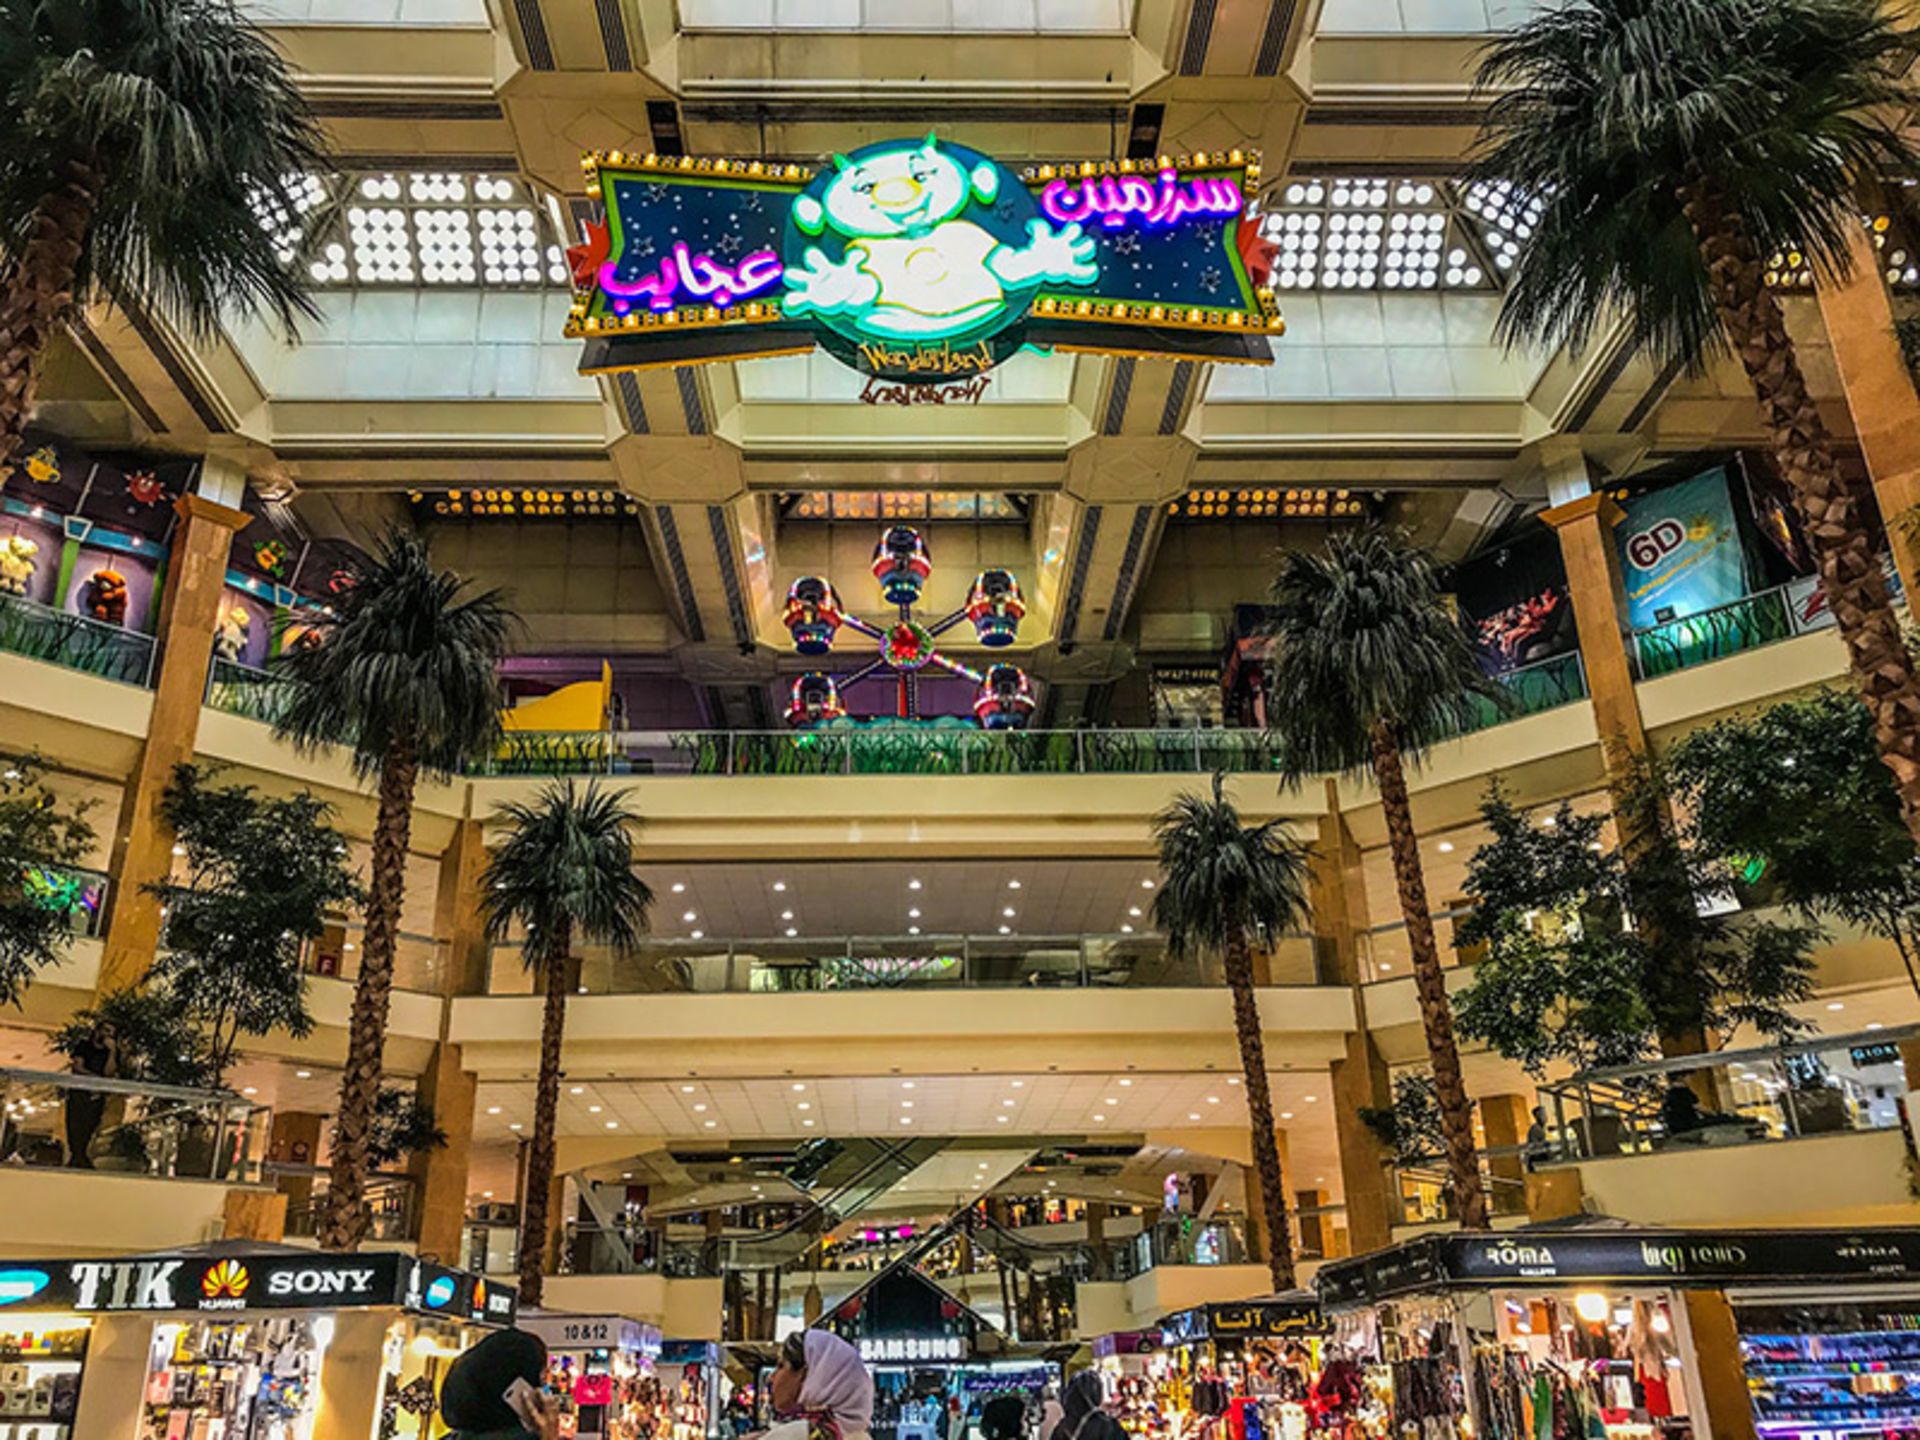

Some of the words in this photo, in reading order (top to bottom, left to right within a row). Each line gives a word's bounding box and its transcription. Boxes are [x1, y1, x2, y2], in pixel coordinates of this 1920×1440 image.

[1042, 167, 1242, 228] سرزمین
[599, 242, 784, 315] عجایب
[858, 339, 994, 374] Wonderland
[1626, 518, 1687, 571] 6D
[70, 1261, 184, 1309] TIK
[268, 1270, 374, 1295] SONY
[859, 1338, 961, 1360] SAMSUNG
